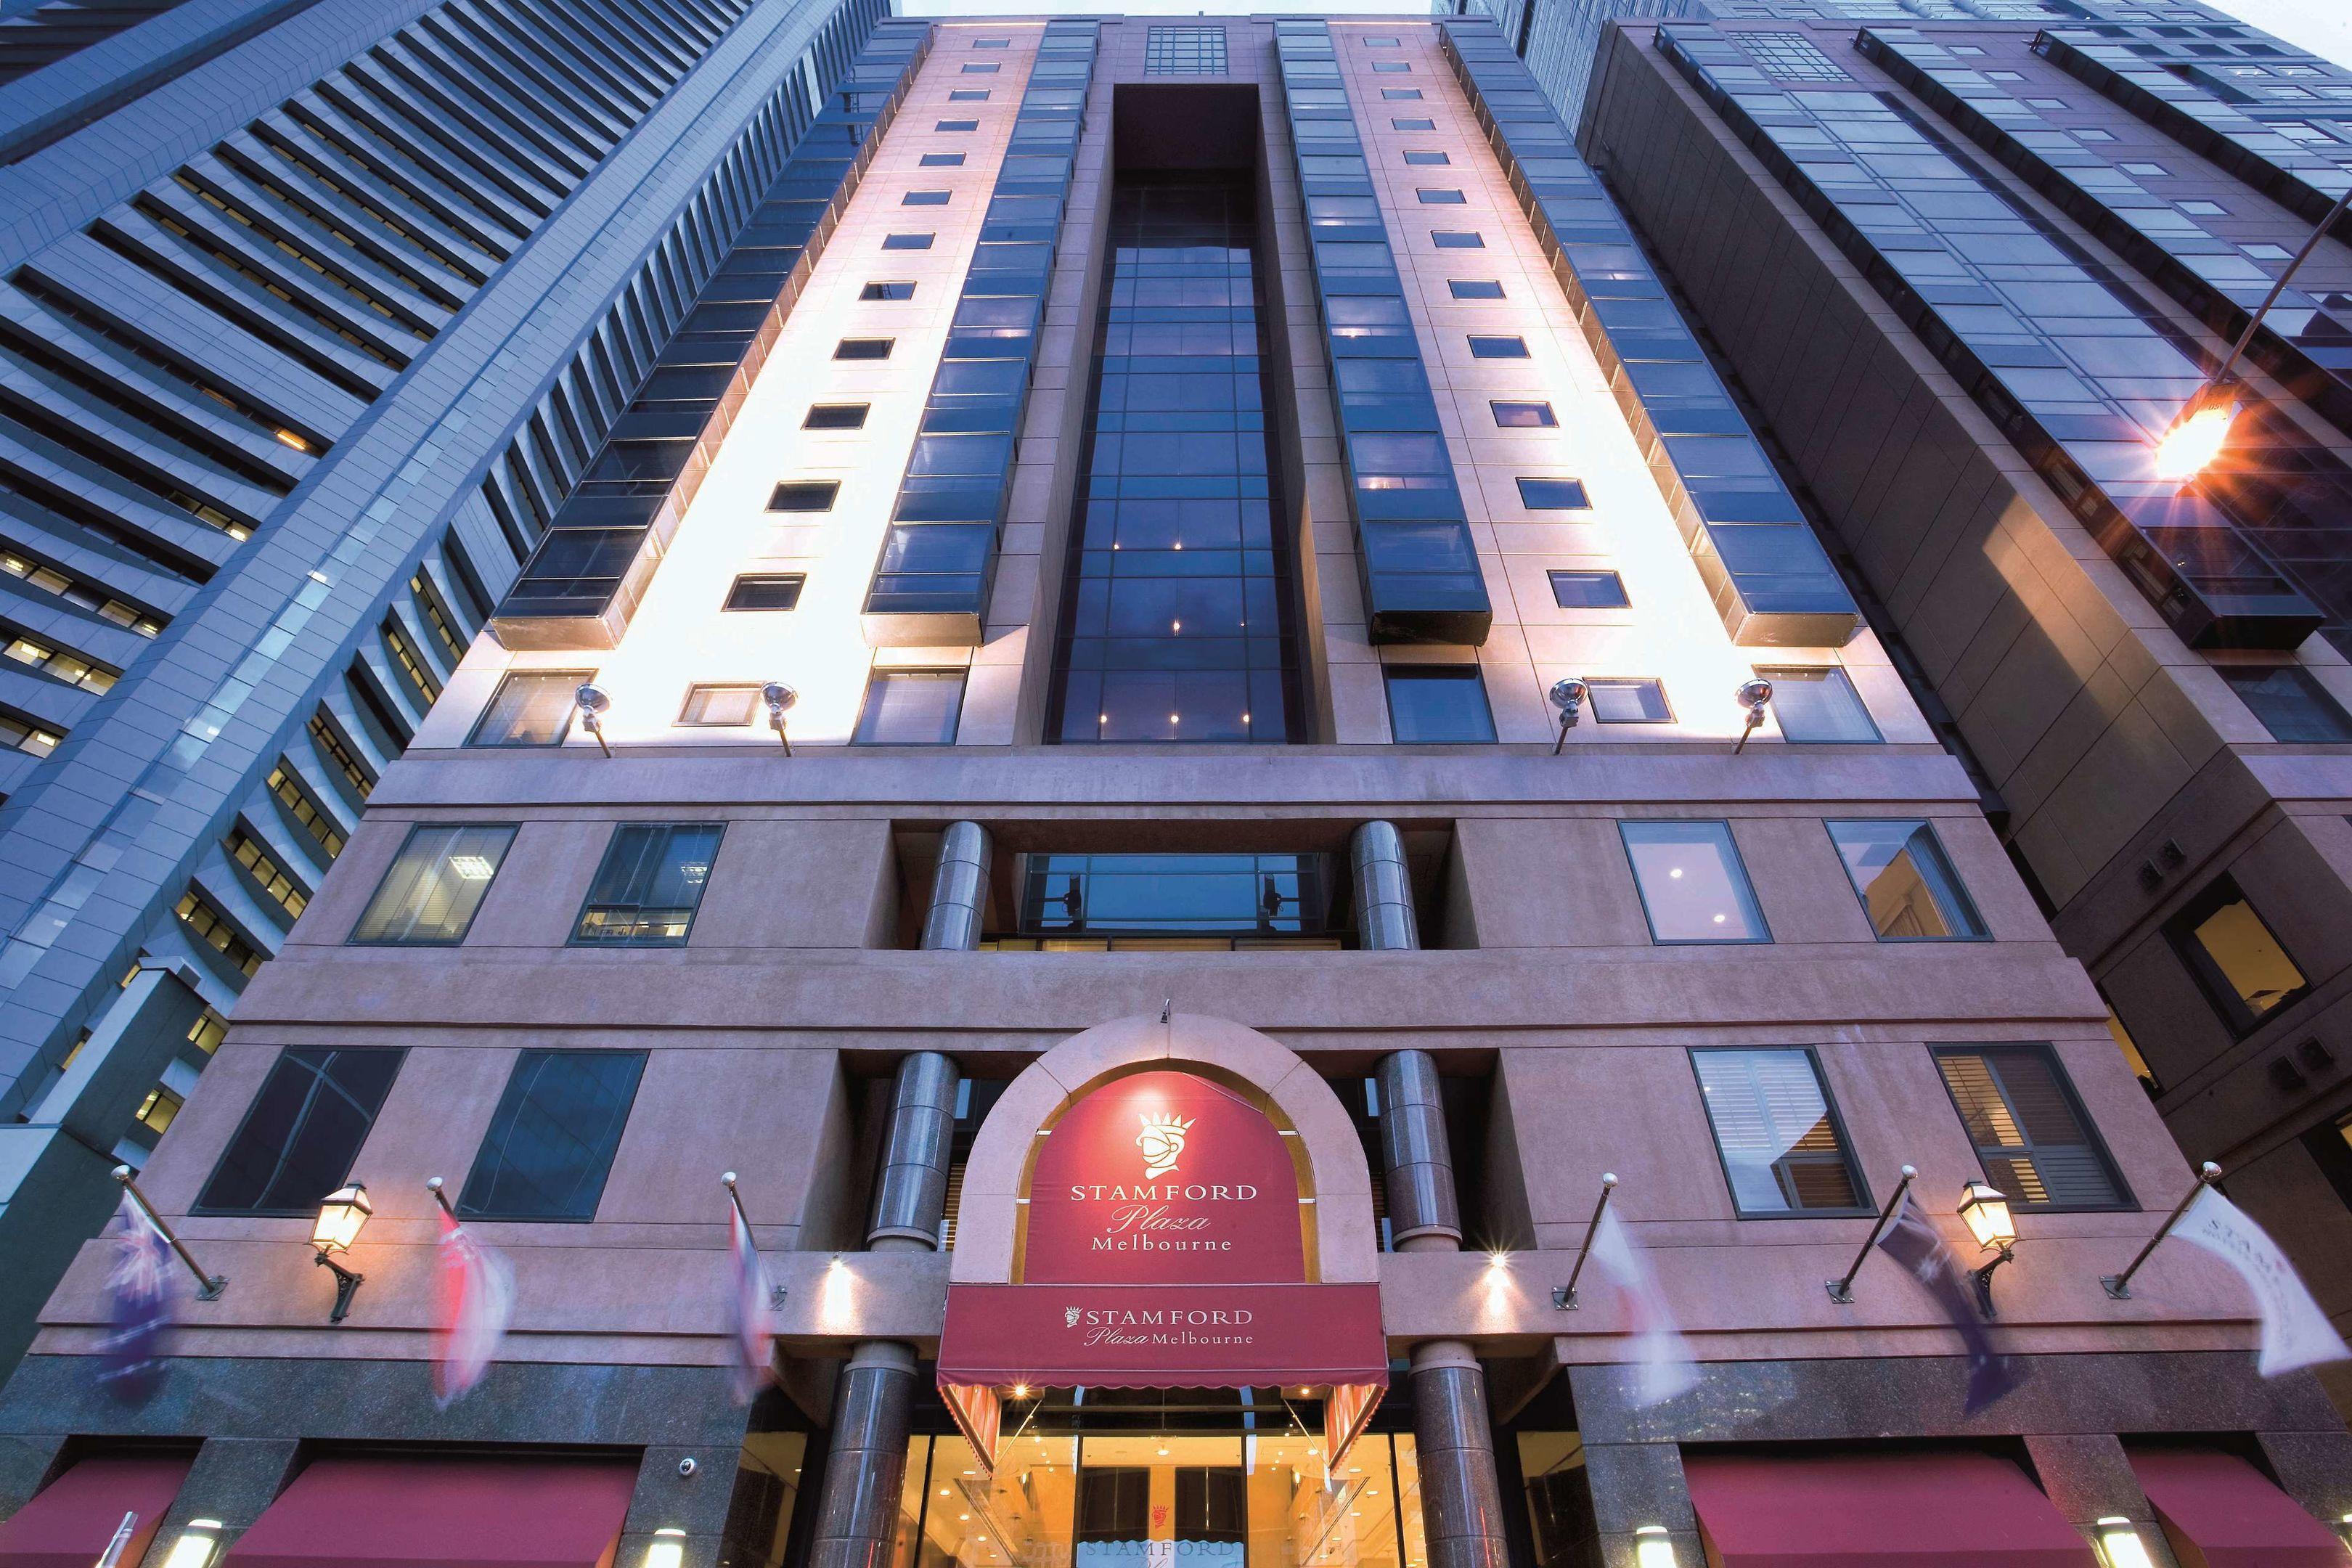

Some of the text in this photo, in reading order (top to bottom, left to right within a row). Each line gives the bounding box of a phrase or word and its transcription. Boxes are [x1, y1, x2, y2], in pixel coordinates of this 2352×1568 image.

[1071, 1185, 1257, 1201] STAMFORD
[1106, 1204, 1212, 1233] Plaza
[1091, 1234, 1232, 1251] Melbourne
[1086, 1310, 1253, 1325] STAMFORD
[1083, 1326, 1254, 1346] Plaza Melbourne
[1086, 1542, 1234, 1556] STAMFORD
